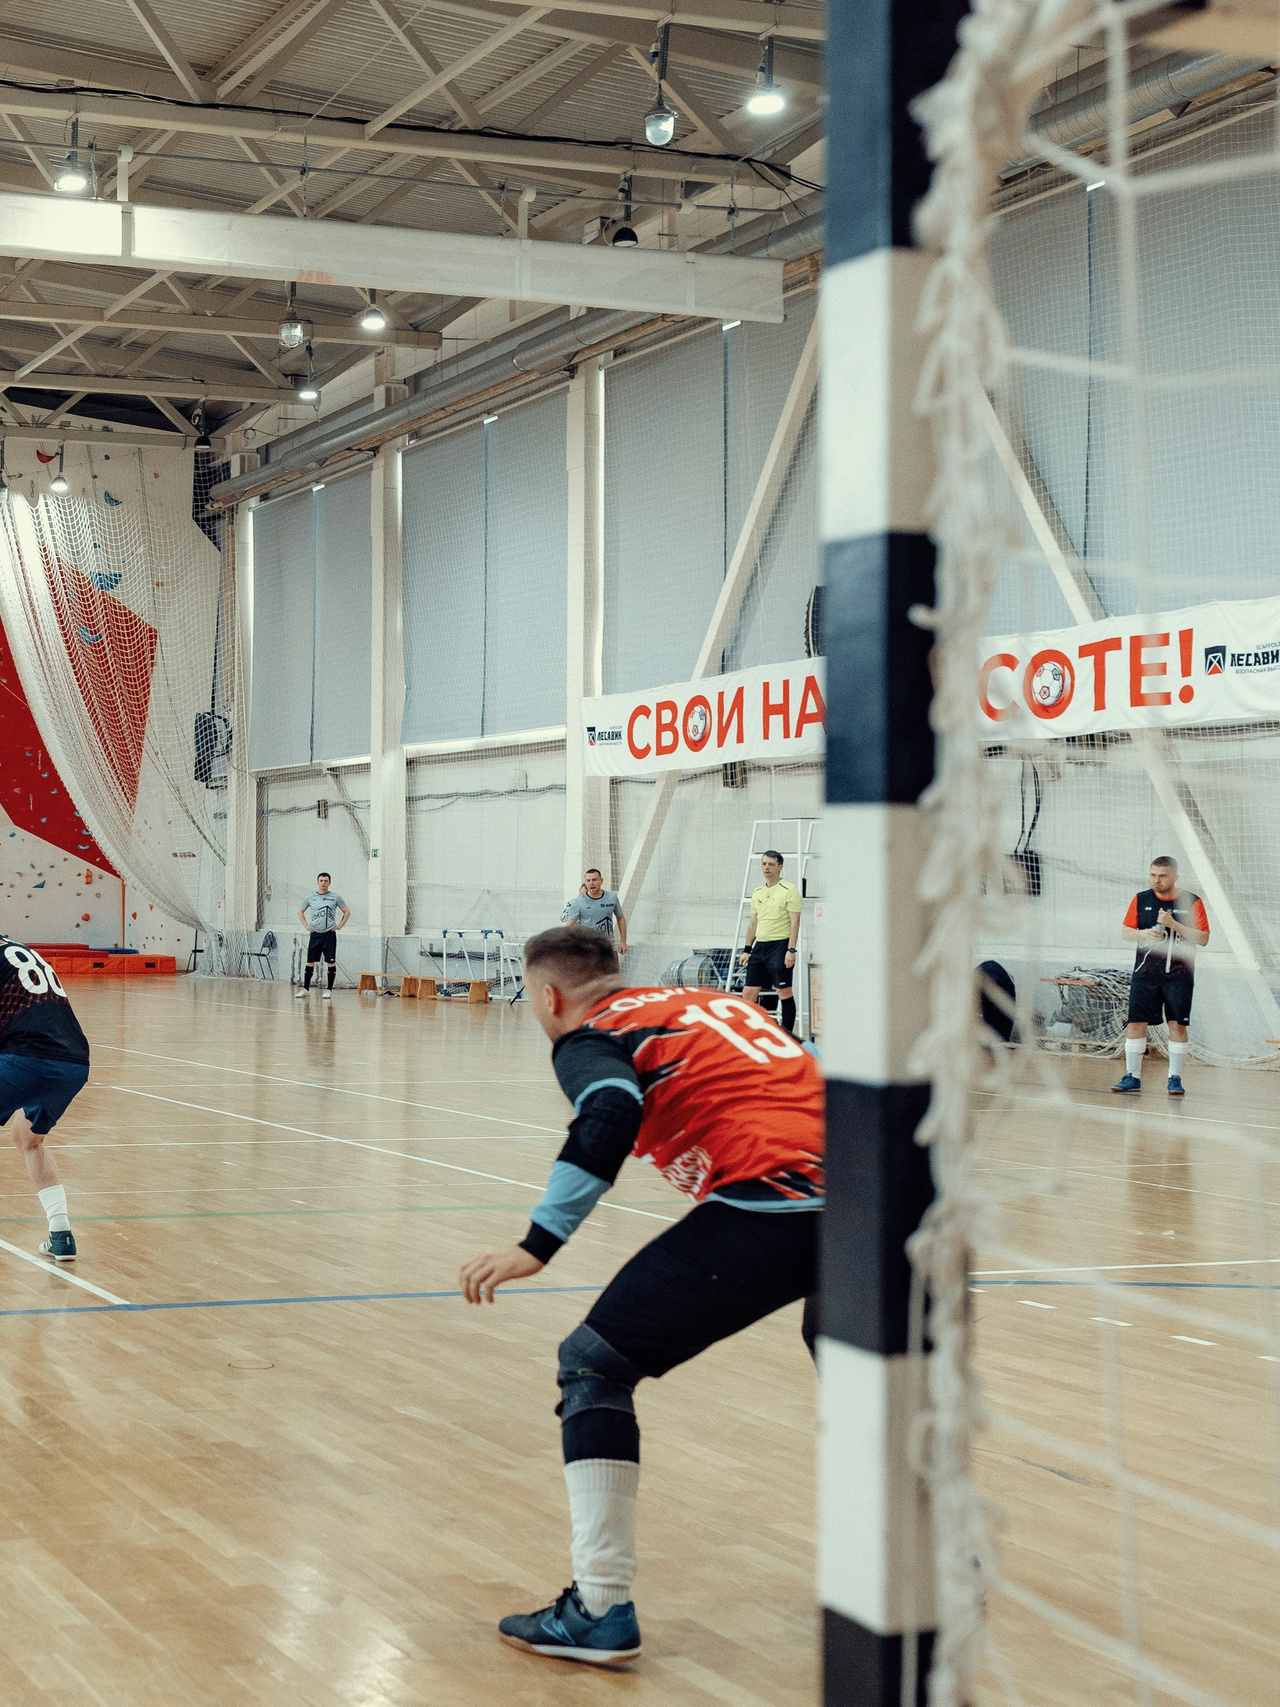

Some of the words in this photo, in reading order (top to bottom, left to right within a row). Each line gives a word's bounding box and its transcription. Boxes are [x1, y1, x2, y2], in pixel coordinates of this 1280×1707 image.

[1230, 649, 1280, 667] ЛЕСАВИ
[626, 685, 745, 761] СВОИ
[761, 674, 828, 741] НА
[677, 997, 804, 1064] 13
